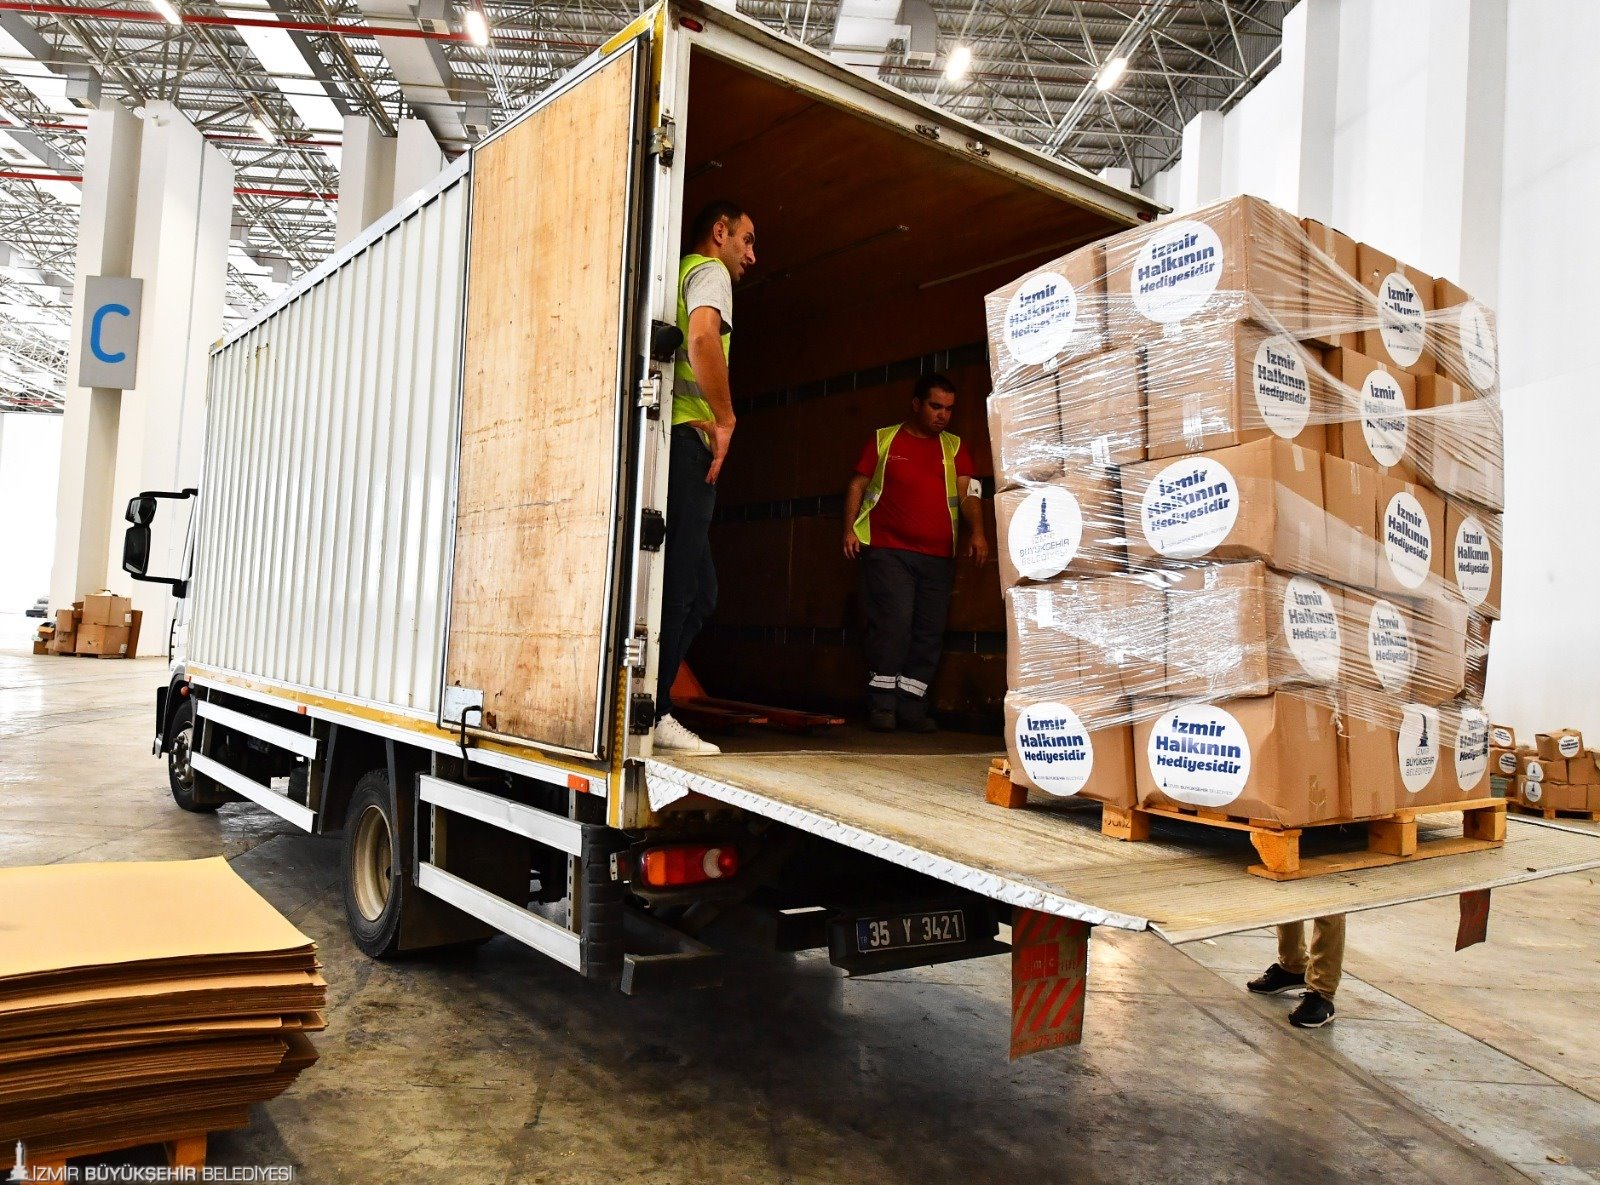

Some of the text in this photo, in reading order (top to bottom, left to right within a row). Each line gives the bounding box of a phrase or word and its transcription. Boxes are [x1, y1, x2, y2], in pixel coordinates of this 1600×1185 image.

[1138, 246, 1215, 282] Halkının
[1140, 261, 1216, 295] Hediyesidir
[91, 303, 131, 364] C
[1257, 365, 1306, 391] Halkının
[1396, 500, 1422, 527] İzmir
[1388, 515, 1429, 549] Halkının
[1388, 531, 1428, 561] Hediyesidir
[1457, 546, 1489, 561] Halkının
[1171, 715, 1226, 737] İzmir
[1020, 733, 1084, 748] Halkının
[1156, 735, 1241, 759] Halkının
[1024, 749, 1086, 764] Hediyesidir
[1156, 754, 1241, 775] Hediyesidir
[869, 921, 890, 947] 35
[903, 918, 911, 943] Y
[921, 914, 960, 941] 3421
